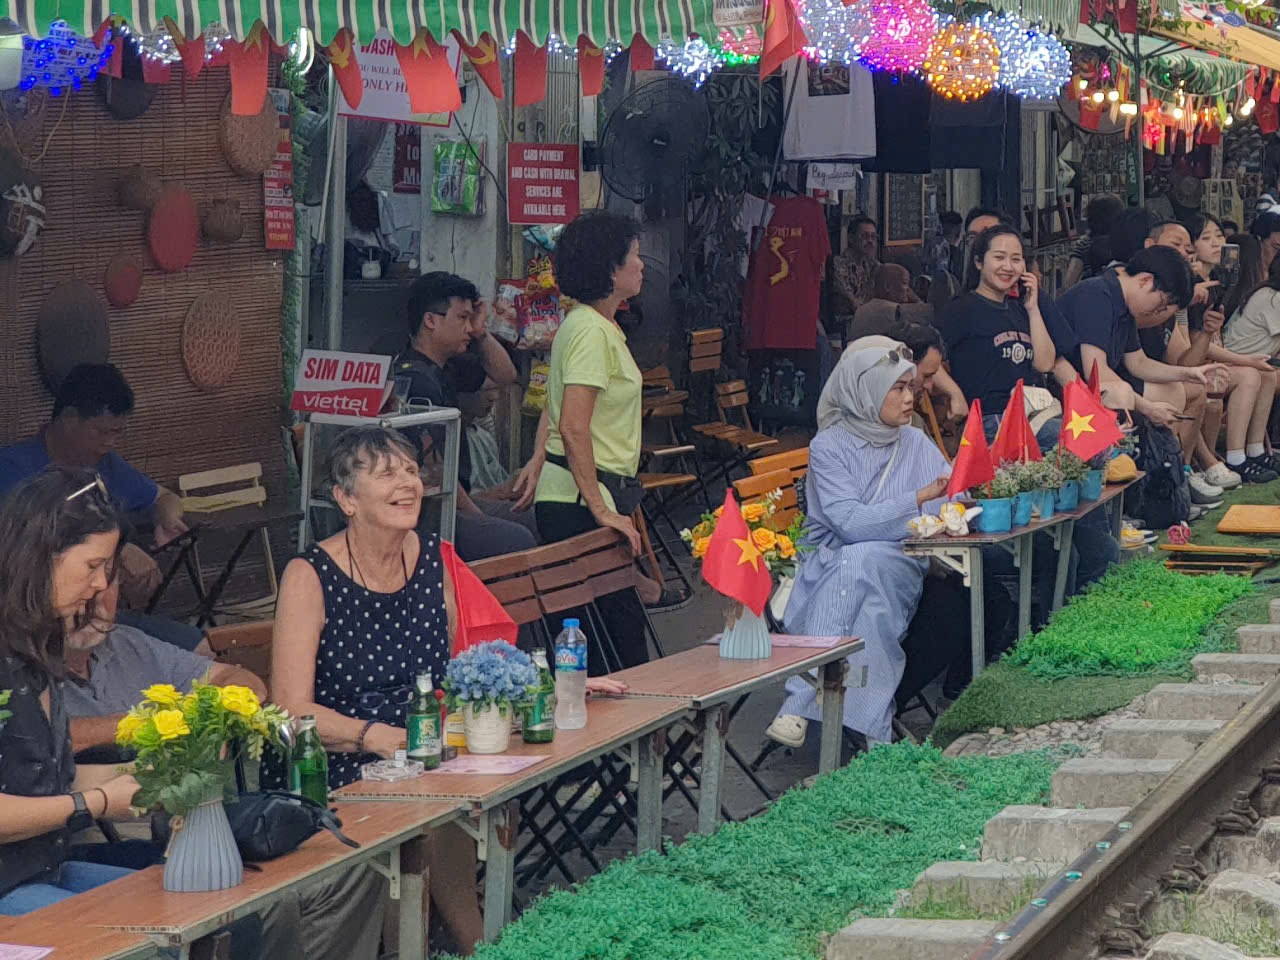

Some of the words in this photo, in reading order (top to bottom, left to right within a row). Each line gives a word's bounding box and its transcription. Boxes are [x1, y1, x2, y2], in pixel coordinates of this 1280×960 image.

[523, 148, 538, 161] CARD
[539, 149, 565, 162] PAYMENT
[511, 166, 523, 179] AND
[524, 166, 539, 179] CASH
[525, 185, 552, 198] SERVICES
[552, 186, 564, 198] ARE
[523, 203, 552, 216] AVAILABLE
[552, 204, 567, 217] HERE
[304, 357, 340, 381] SIM
[341, 360, 382, 385] DATA
[302, 393, 369, 412] viettel
